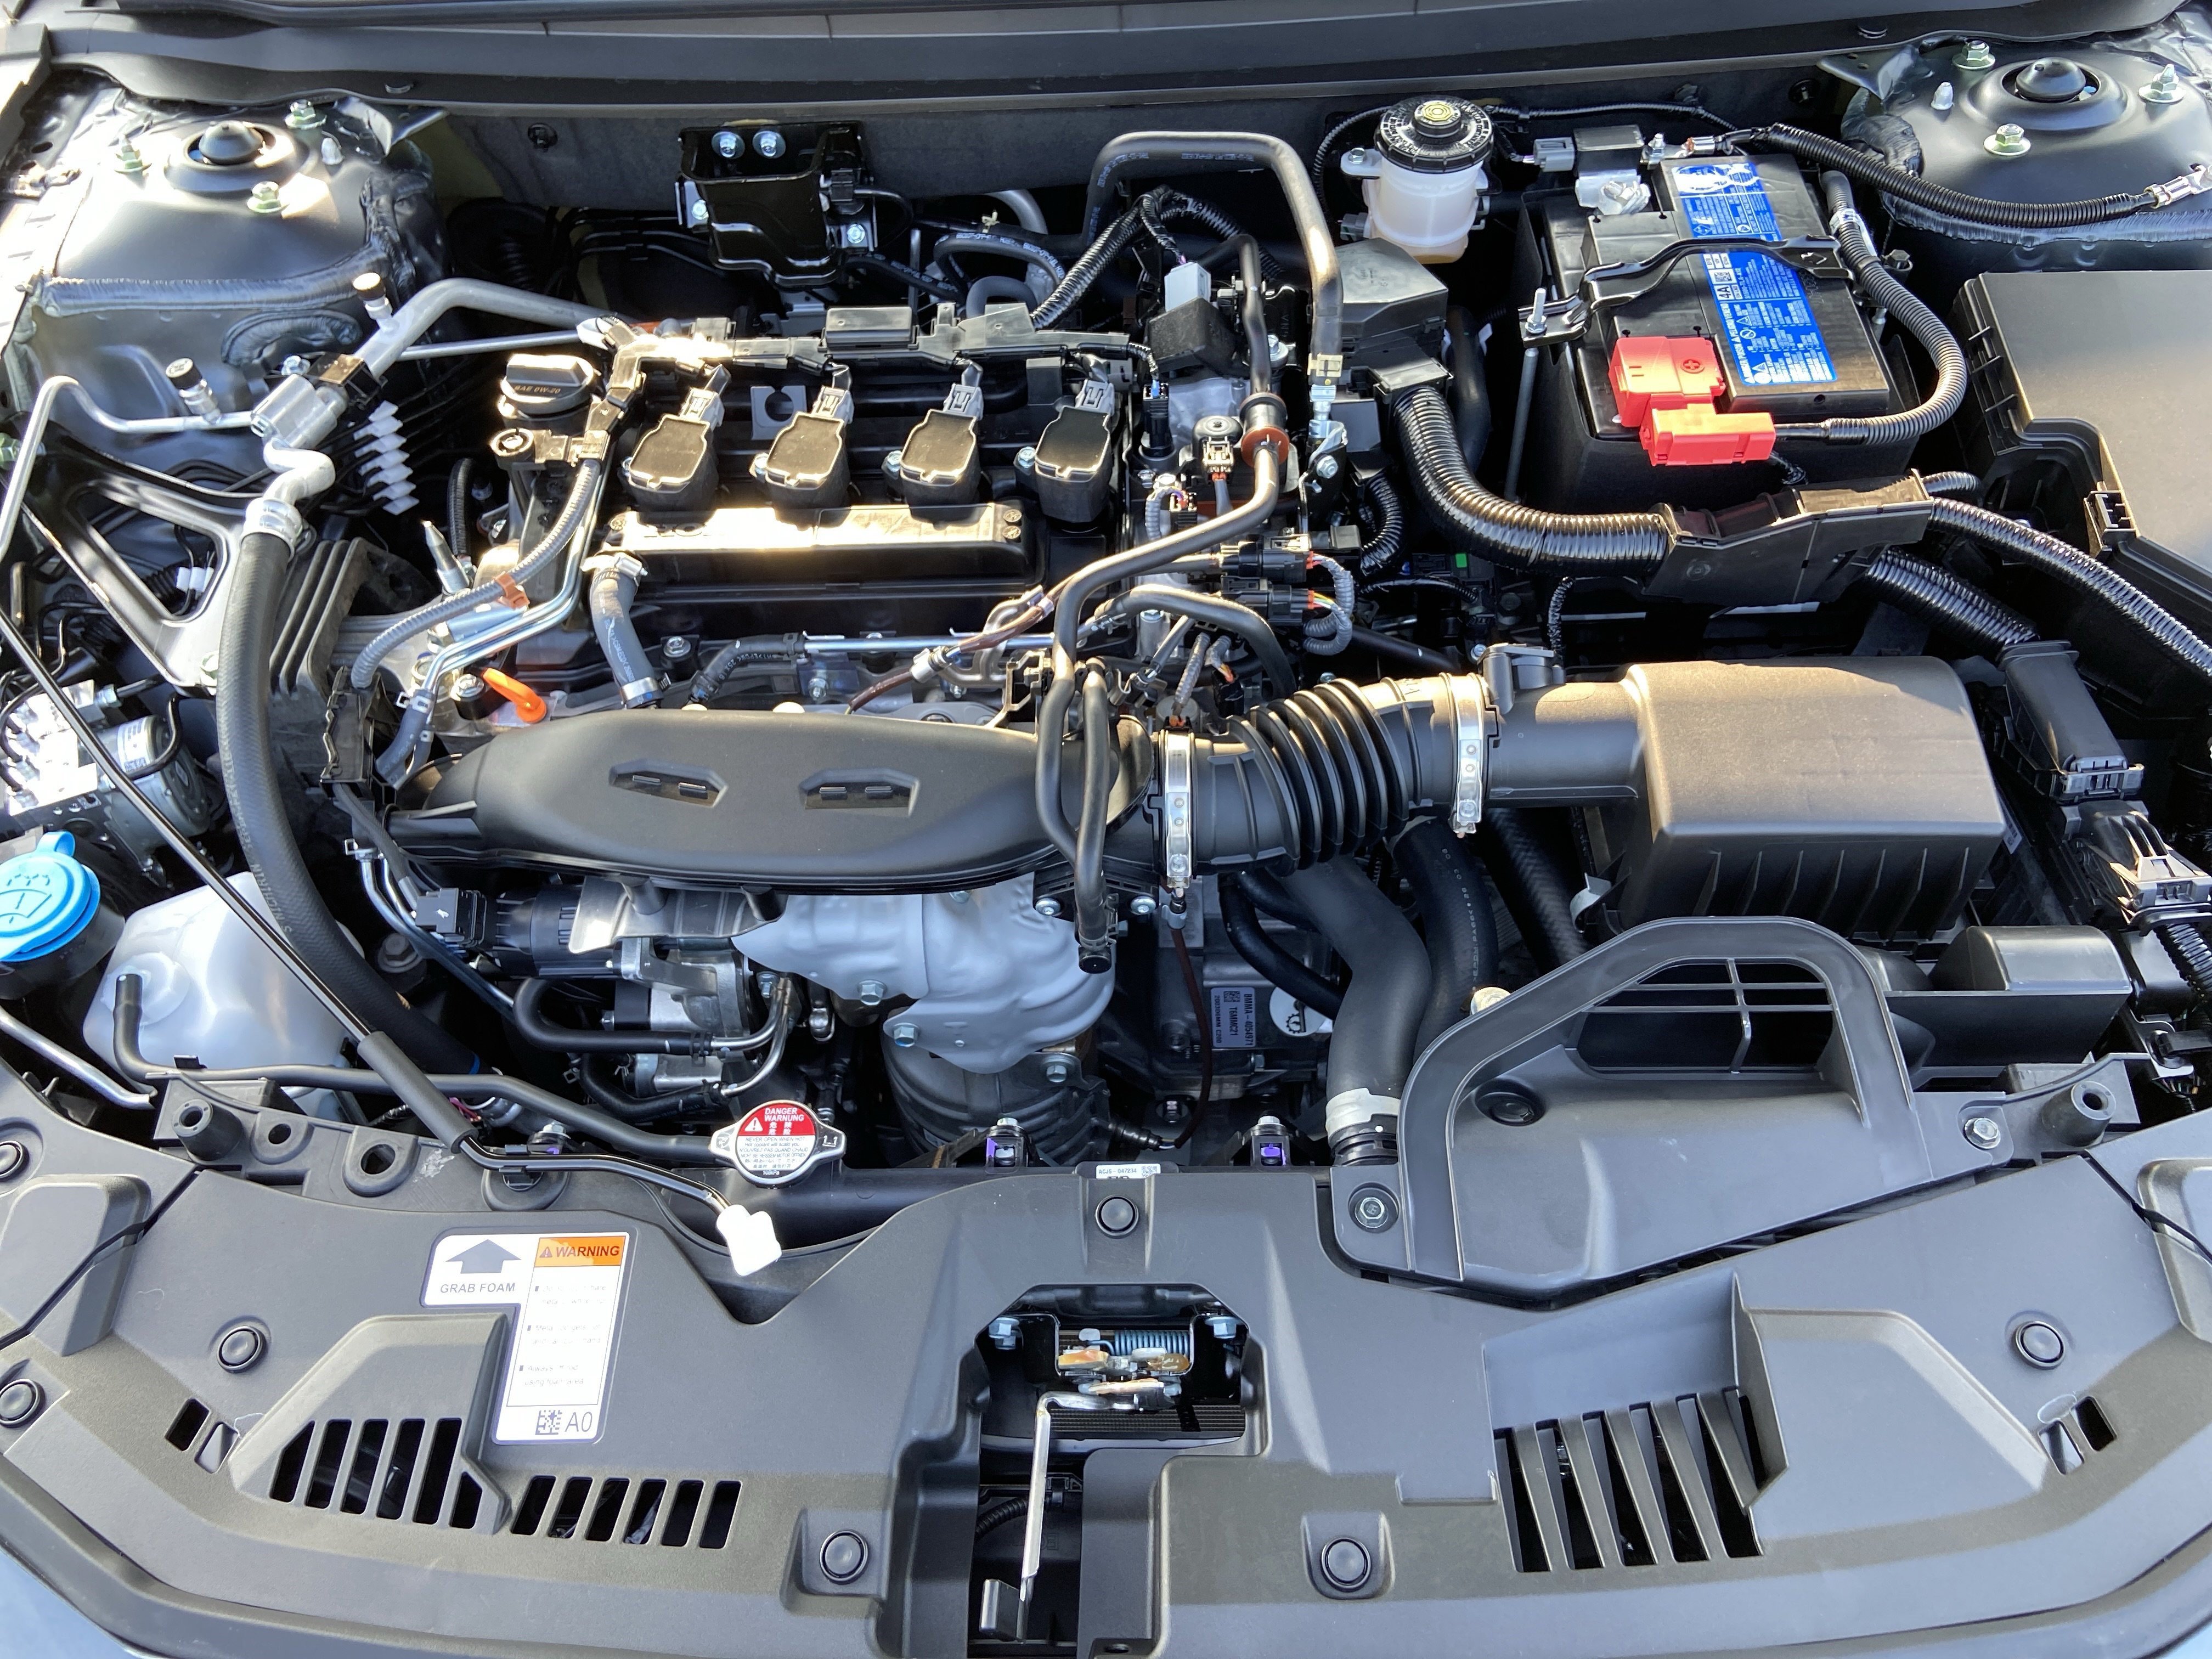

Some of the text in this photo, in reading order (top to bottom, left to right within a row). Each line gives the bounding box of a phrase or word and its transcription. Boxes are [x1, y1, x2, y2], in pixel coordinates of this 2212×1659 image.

[1717, 286, 1731, 298] 4A
[250, 864, 285, 921] NICHIRIN
[1229, 1007, 1238, 1036] T6MMC21
[556, 1246, 620, 1257] WARNING
[440, 1283, 515, 1293] GRAB FOAM
[565, 1411, 593, 1433] A0
